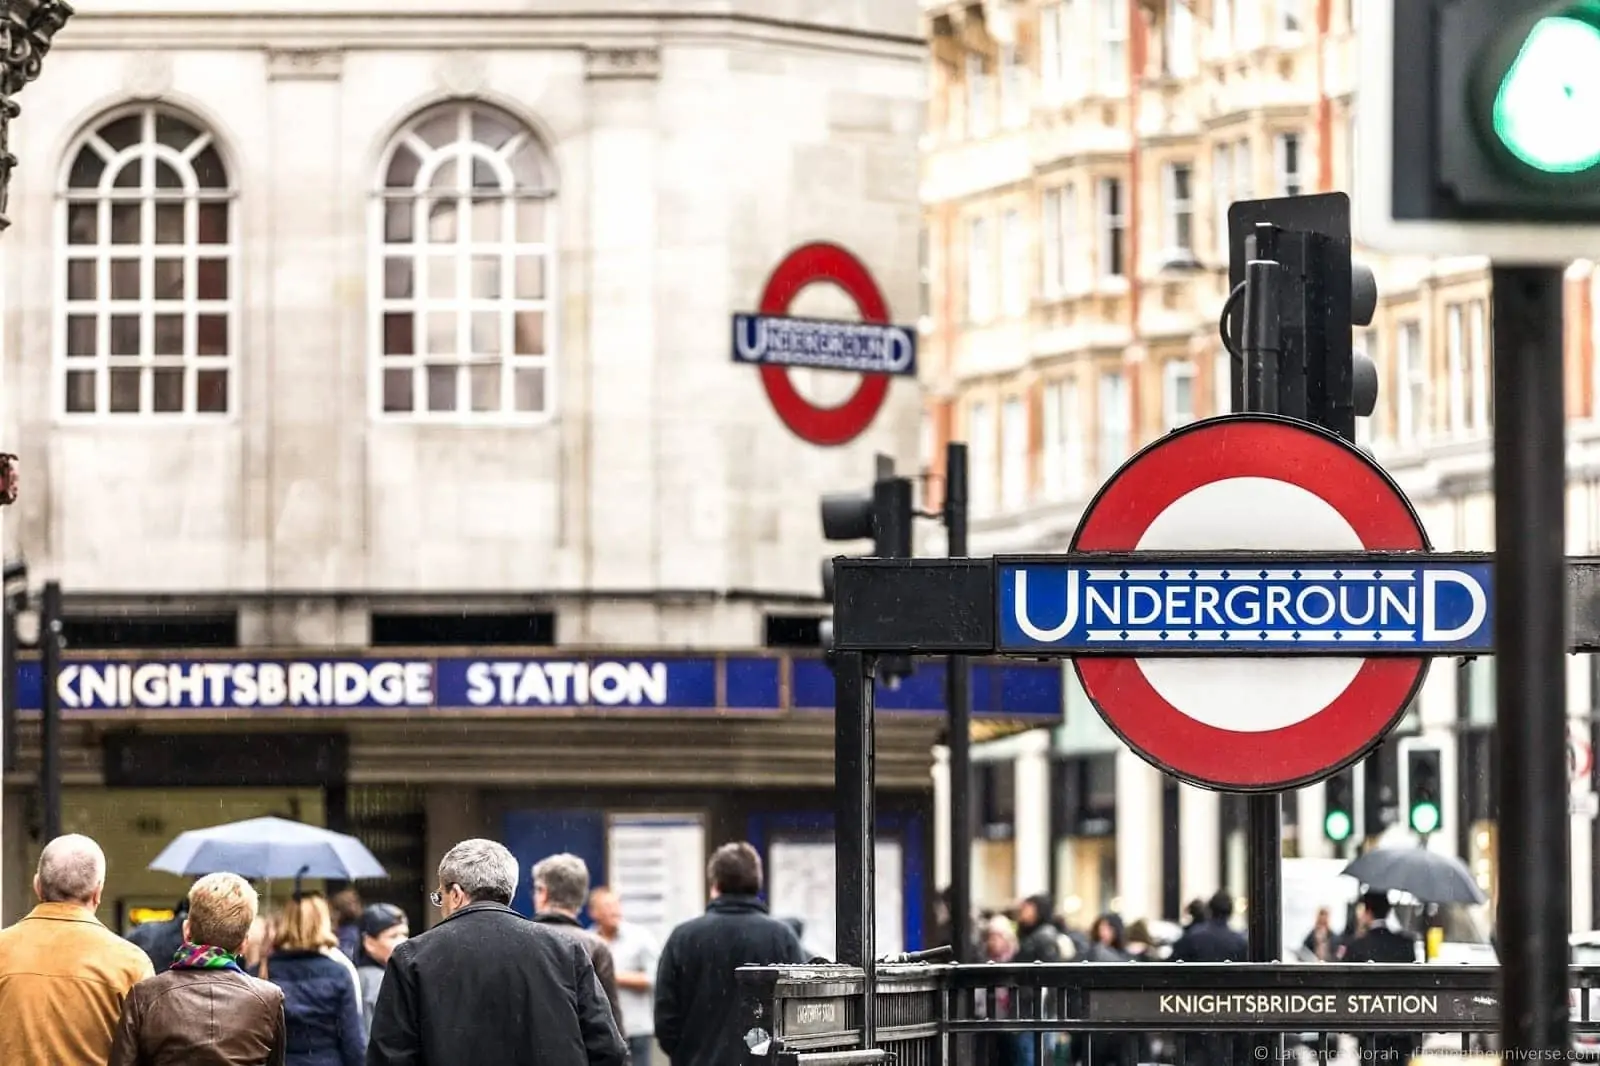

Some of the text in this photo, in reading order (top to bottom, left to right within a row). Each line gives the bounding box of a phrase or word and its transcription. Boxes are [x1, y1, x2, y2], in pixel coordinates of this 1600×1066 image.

[736, 316, 912, 373] UNDERGROUND
[1014, 569, 1487, 642] UNDERGROUND
[56, 661, 668, 708] KNIGHTSBRIDGE STATION
[1159, 994, 1438, 1014] KNIGHTSBRIDGE STATION
